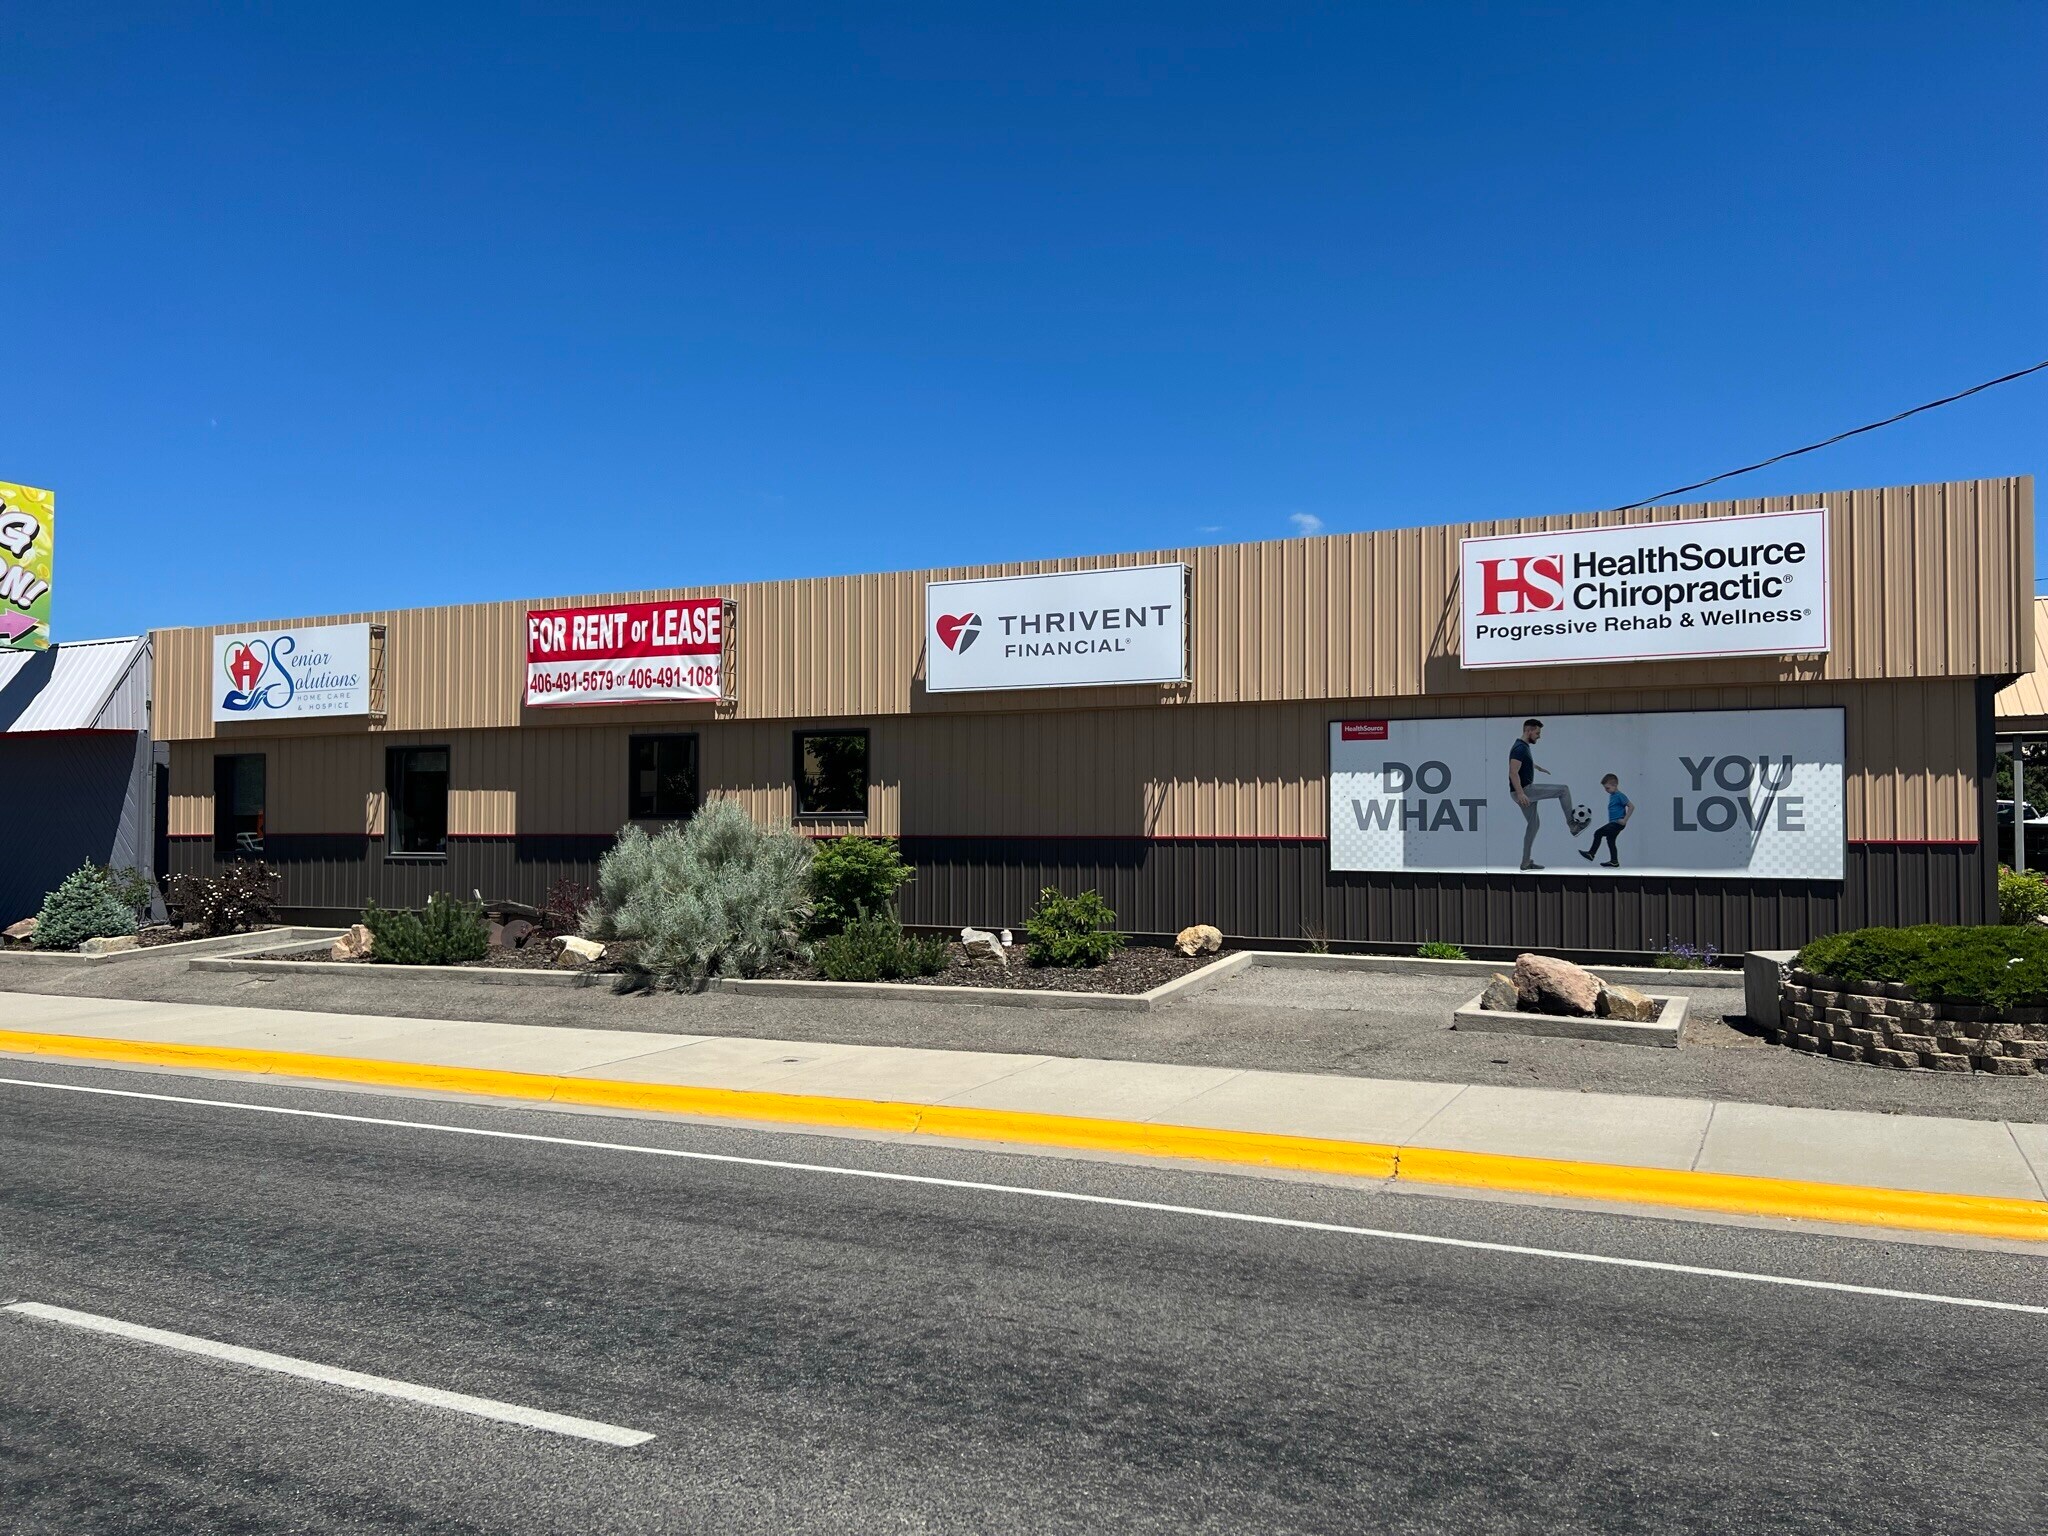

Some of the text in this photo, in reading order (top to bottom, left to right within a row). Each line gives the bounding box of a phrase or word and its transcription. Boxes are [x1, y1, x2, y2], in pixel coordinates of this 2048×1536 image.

[1573, 541, 1806, 579] HealthSource
[1475, 554, 1564, 616] HS
[529, 606, 721, 654] FOR RENT or LEASE
[998, 604, 1172, 636] THRIVENT
[1476, 618, 1598, 641] Progressive
[1604, 615, 1673, 632] Rehab
[1679, 613, 1696, 628] &
[297, 692, 351, 702] HOME CARE
[530, 670, 614, 693] 406-491-5679
[616, 674, 626, 686] or
[309, 701, 349, 710] HOSPICE
[1382, 760, 1452, 795] DO
[1678, 755, 1793, 791] YOU
[1352, 798, 1487, 832] WHAT
[1672, 796, 1806, 832] LOVE
